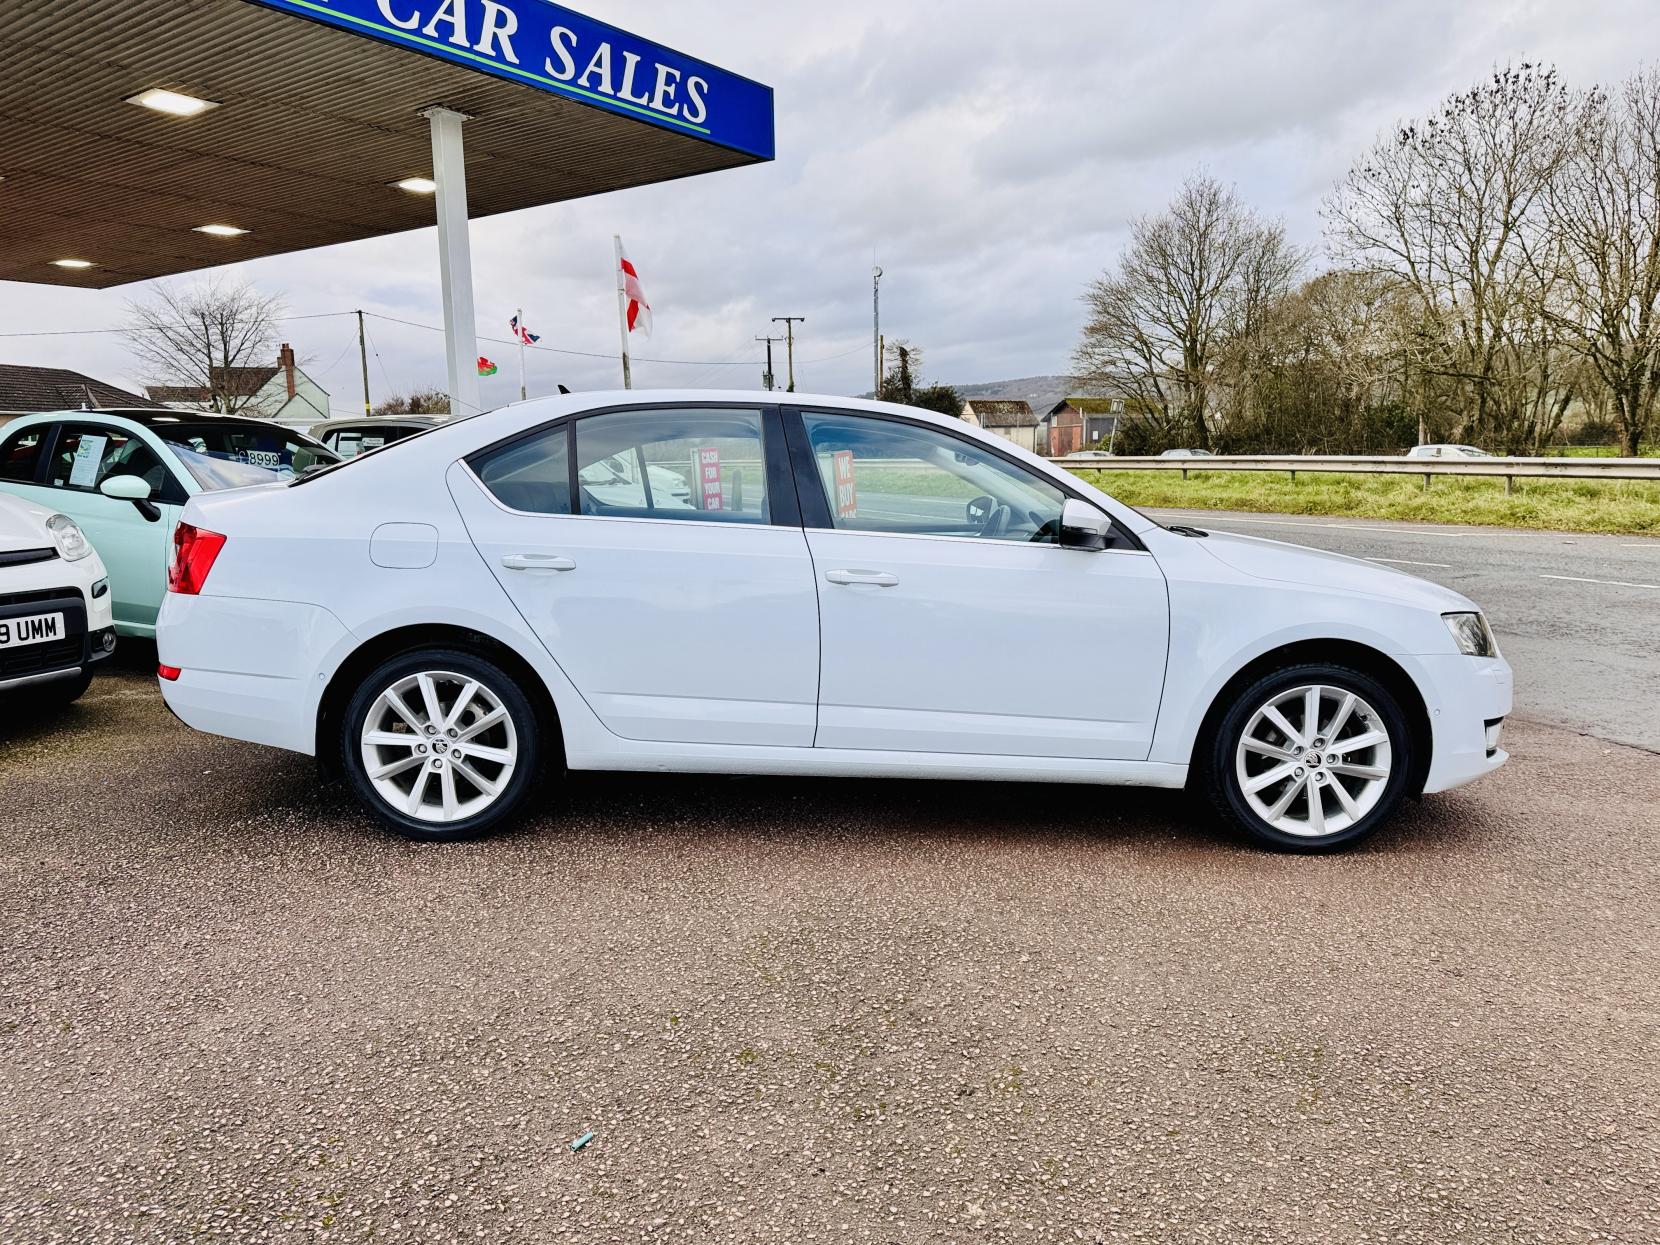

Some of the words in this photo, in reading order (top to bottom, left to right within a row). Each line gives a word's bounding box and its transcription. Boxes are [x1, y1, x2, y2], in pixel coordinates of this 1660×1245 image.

[377, 0, 519, 64] CAR
[544, 26, 709, 124] SALES
[702, 451, 718, 464] CASH
[705, 467, 717, 480] FOR
[838, 456, 850, 479] WE
[704, 481, 720, 494] YOUR
[840, 482, 854, 506] BUY
[708, 497, 720, 510] CAR
[17, 617, 57, 641] UMM
